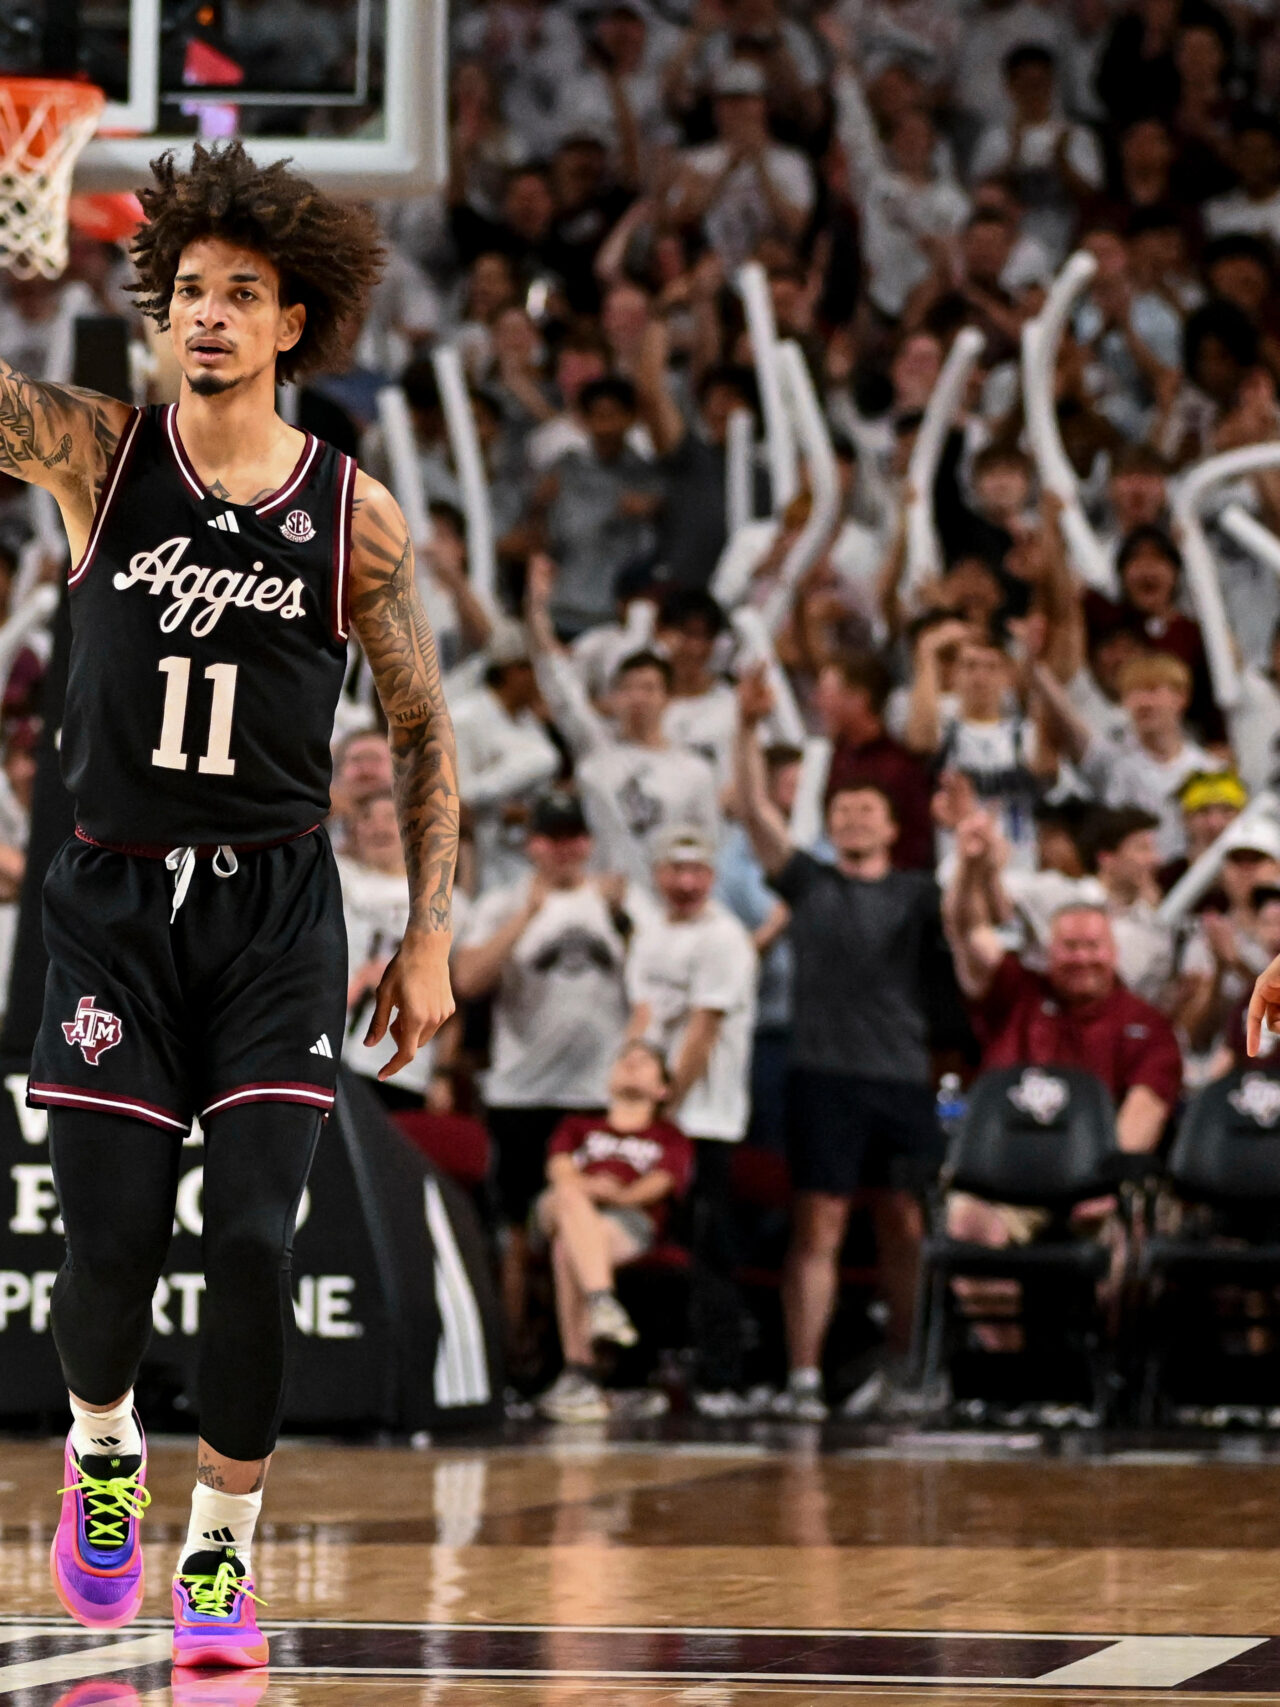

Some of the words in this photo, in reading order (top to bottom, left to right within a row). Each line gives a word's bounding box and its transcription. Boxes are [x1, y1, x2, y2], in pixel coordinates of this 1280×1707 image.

[288, 511, 310, 534] SEC
[113, 537, 307, 637] Aggies
[151, 655, 238, 776] 11
